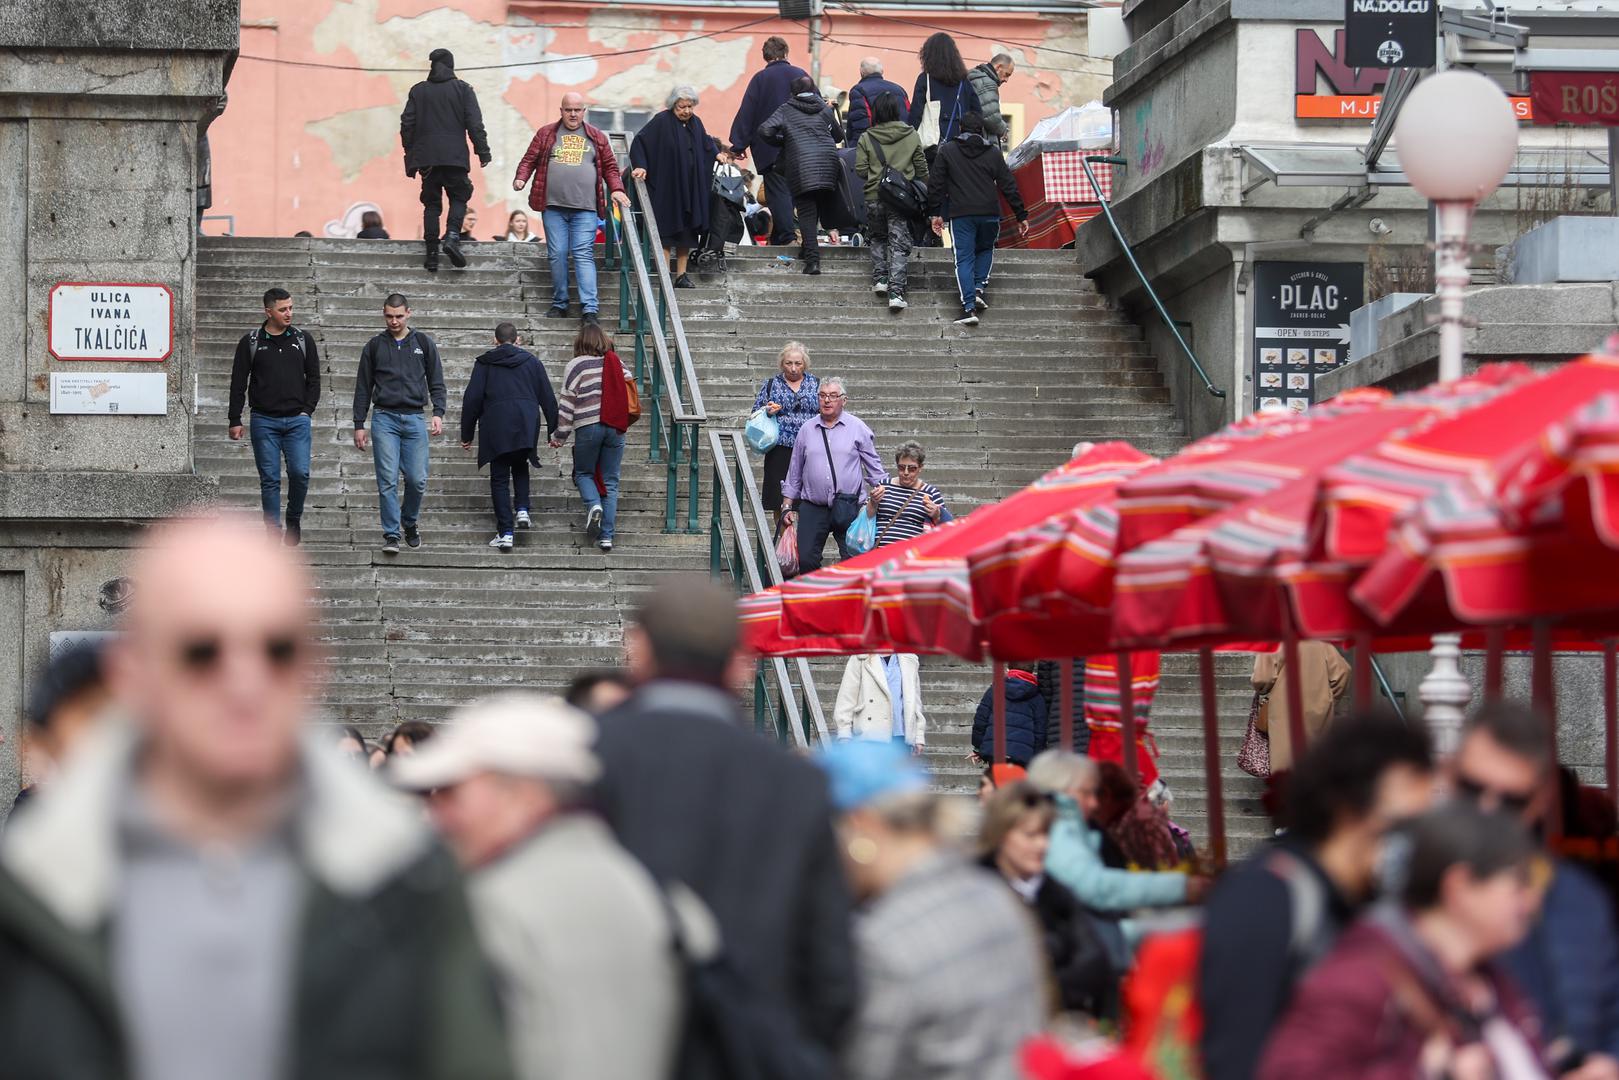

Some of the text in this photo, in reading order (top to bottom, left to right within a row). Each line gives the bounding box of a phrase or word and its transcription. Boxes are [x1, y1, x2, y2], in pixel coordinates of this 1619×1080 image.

[91, 292, 131, 303] ULICA
[1280, 284, 1339, 310] PLAC
[91, 308, 131, 319] IVANA
[75, 324, 148, 351] TKALČIĆA
[1277, 329, 1298, 337] OPEN
